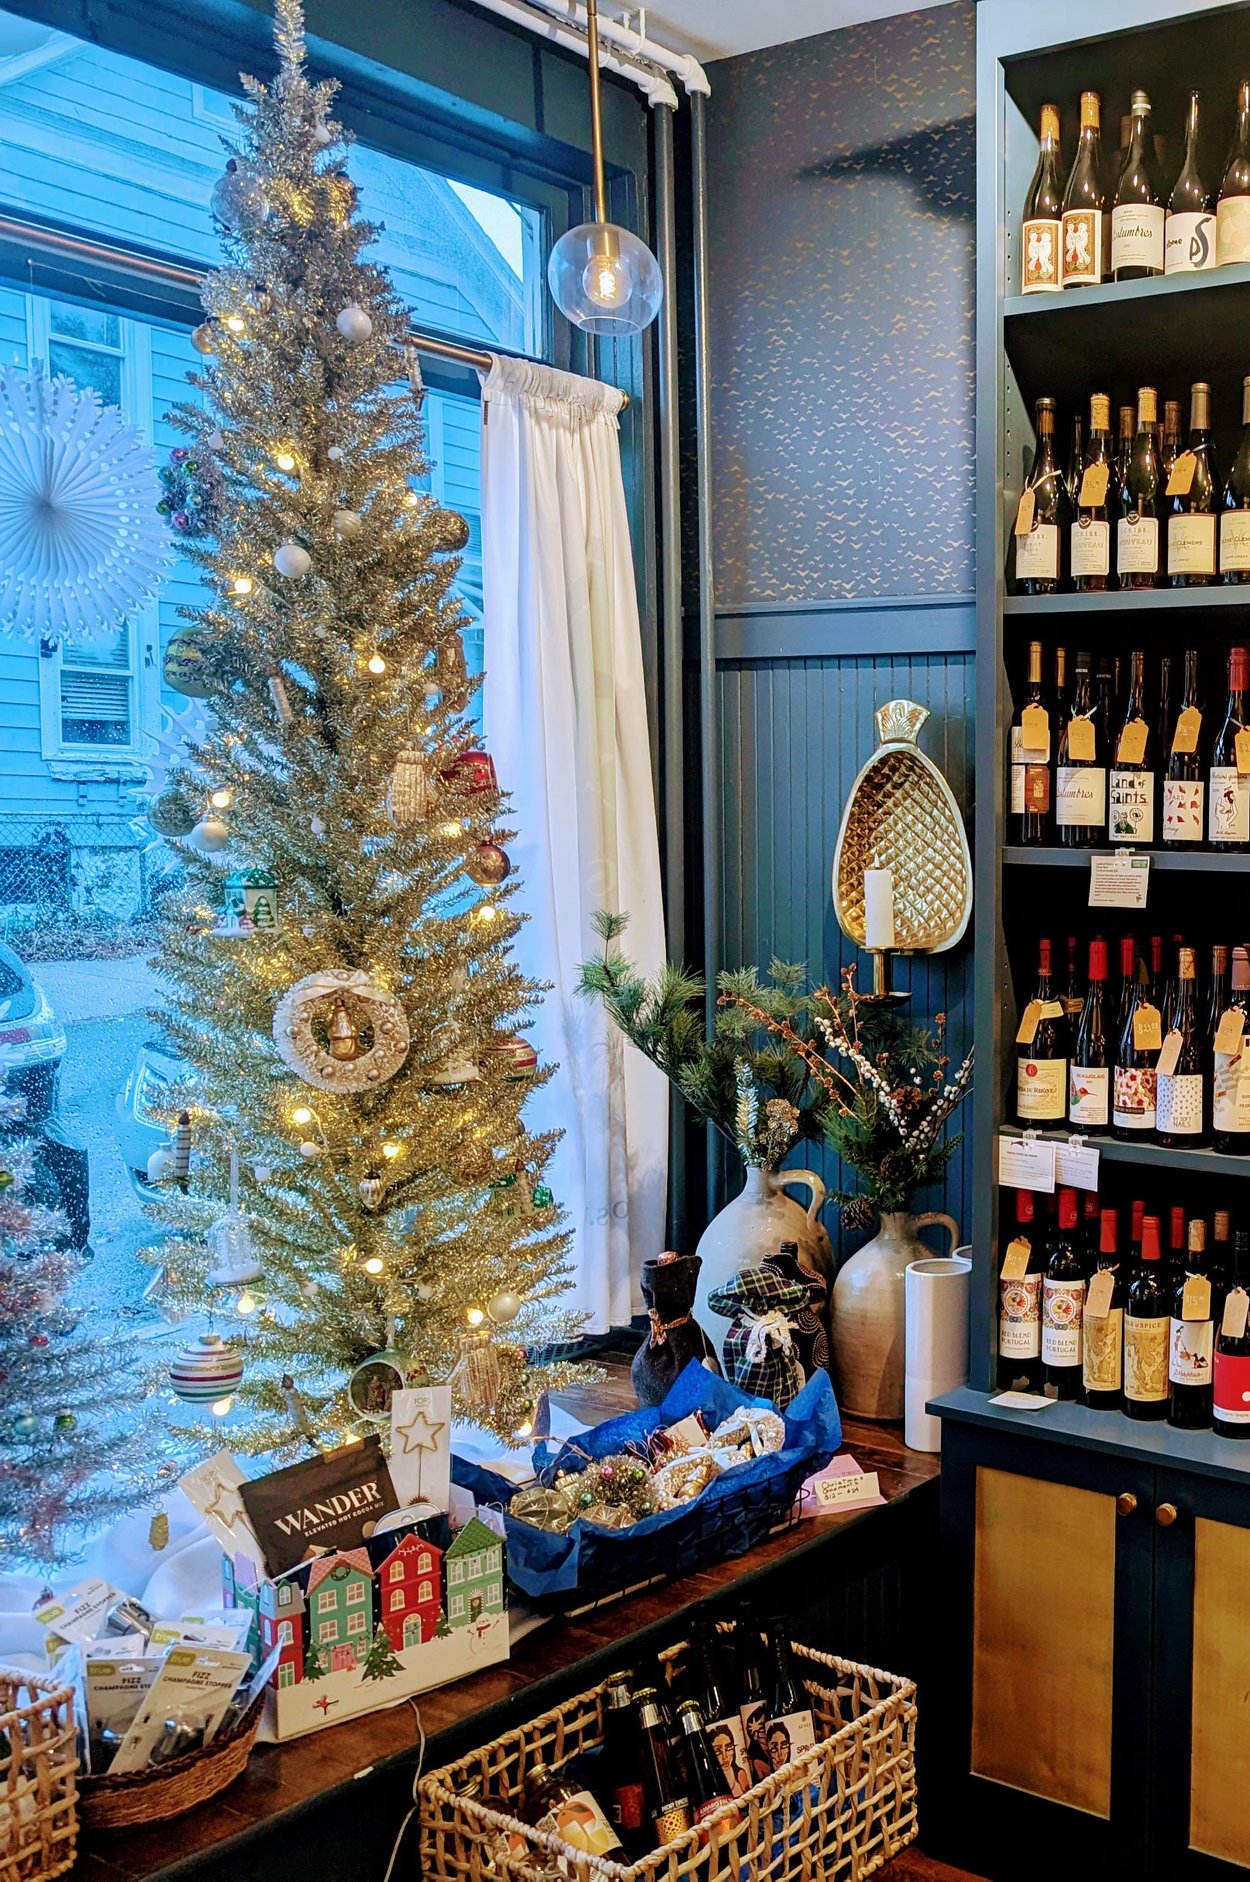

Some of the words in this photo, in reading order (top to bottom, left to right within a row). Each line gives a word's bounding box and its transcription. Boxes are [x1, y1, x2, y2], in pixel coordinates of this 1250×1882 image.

[1111, 773, 1137, 789] Land
[1138, 780, 1146, 789] of
[1111, 789, 1148, 804] Saints
[821, 1475, 864, 1490] Christmas
[273, 1481, 383, 1537] WANDER
[304, 1518, 337, 1538] ELEVATED
[338, 1513, 353, 1526] HOT
[352, 1504, 375, 1520] COCOA
[374, 1500, 386, 1511] MIX
[74, 1601, 91, 1615] FIZZ
[122, 1676, 142, 1685] FIZZ
[162, 1675, 204, 1688] CHAMPAGNE
[204, 1681, 233, 1690] STOPPER
[191, 1670, 211, 1680] FIZZ
[93, 1684, 136, 1692] CHAMPAGNE
